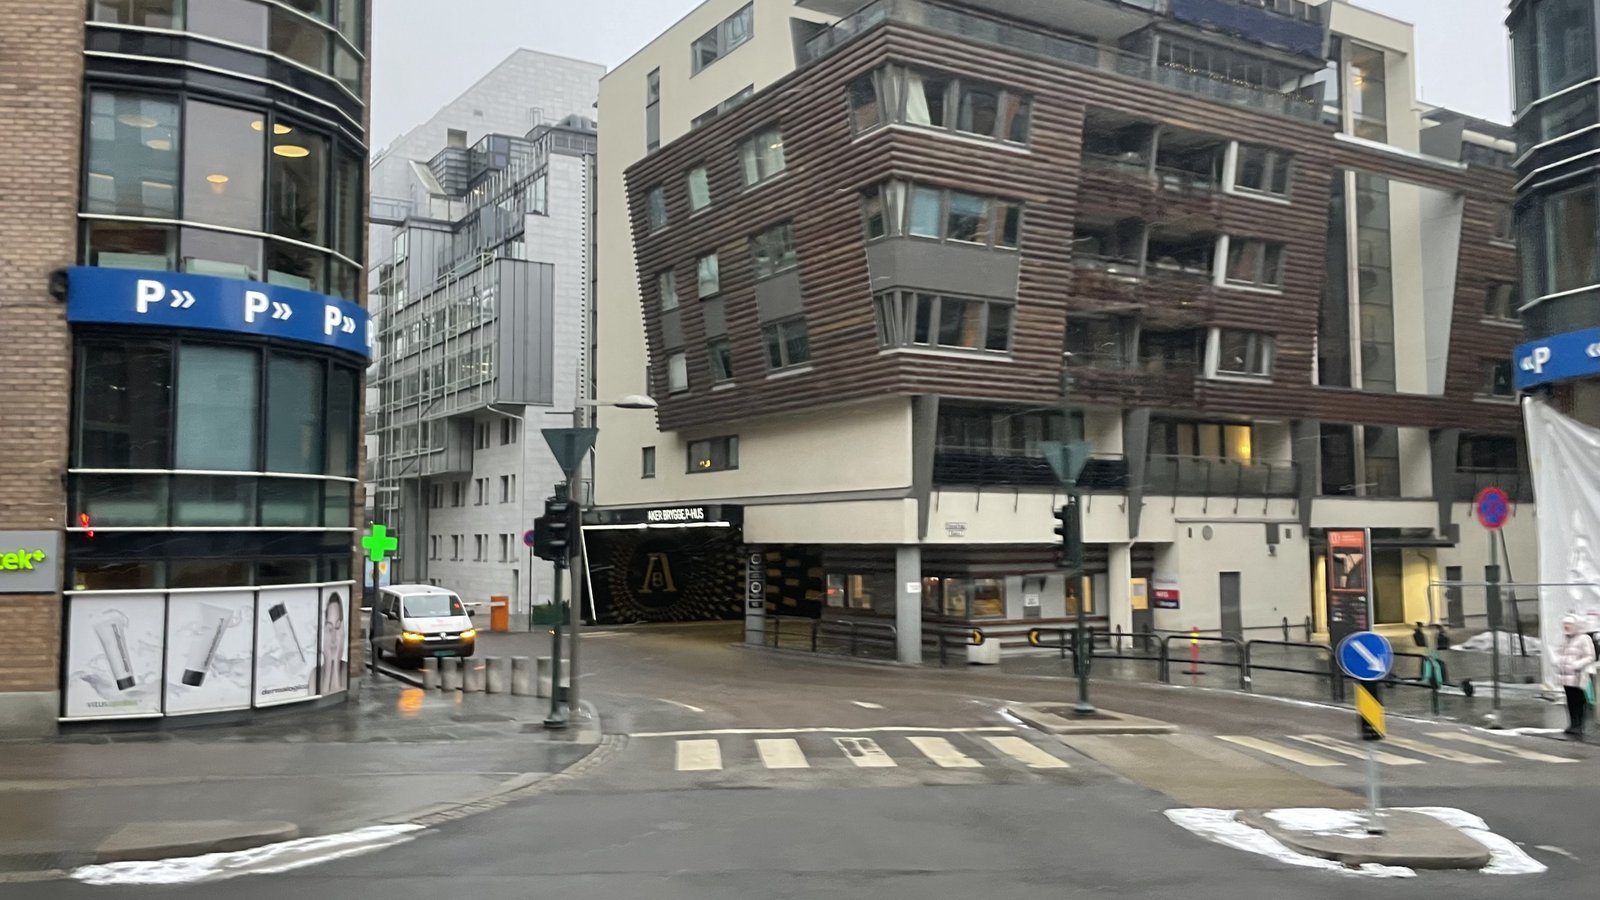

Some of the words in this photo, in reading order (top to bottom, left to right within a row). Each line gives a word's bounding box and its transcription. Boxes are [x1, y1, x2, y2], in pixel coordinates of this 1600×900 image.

[136, 279, 166, 314] P
[244, 290, 270, 323] P
[324, 304, 343, 336] P
[1532, 346, 1551, 374] P
[648, 509, 663, 521] AKER
[662, 508, 686, 521] BRYGGE
[685, 507, 704, 520] P-HUS
